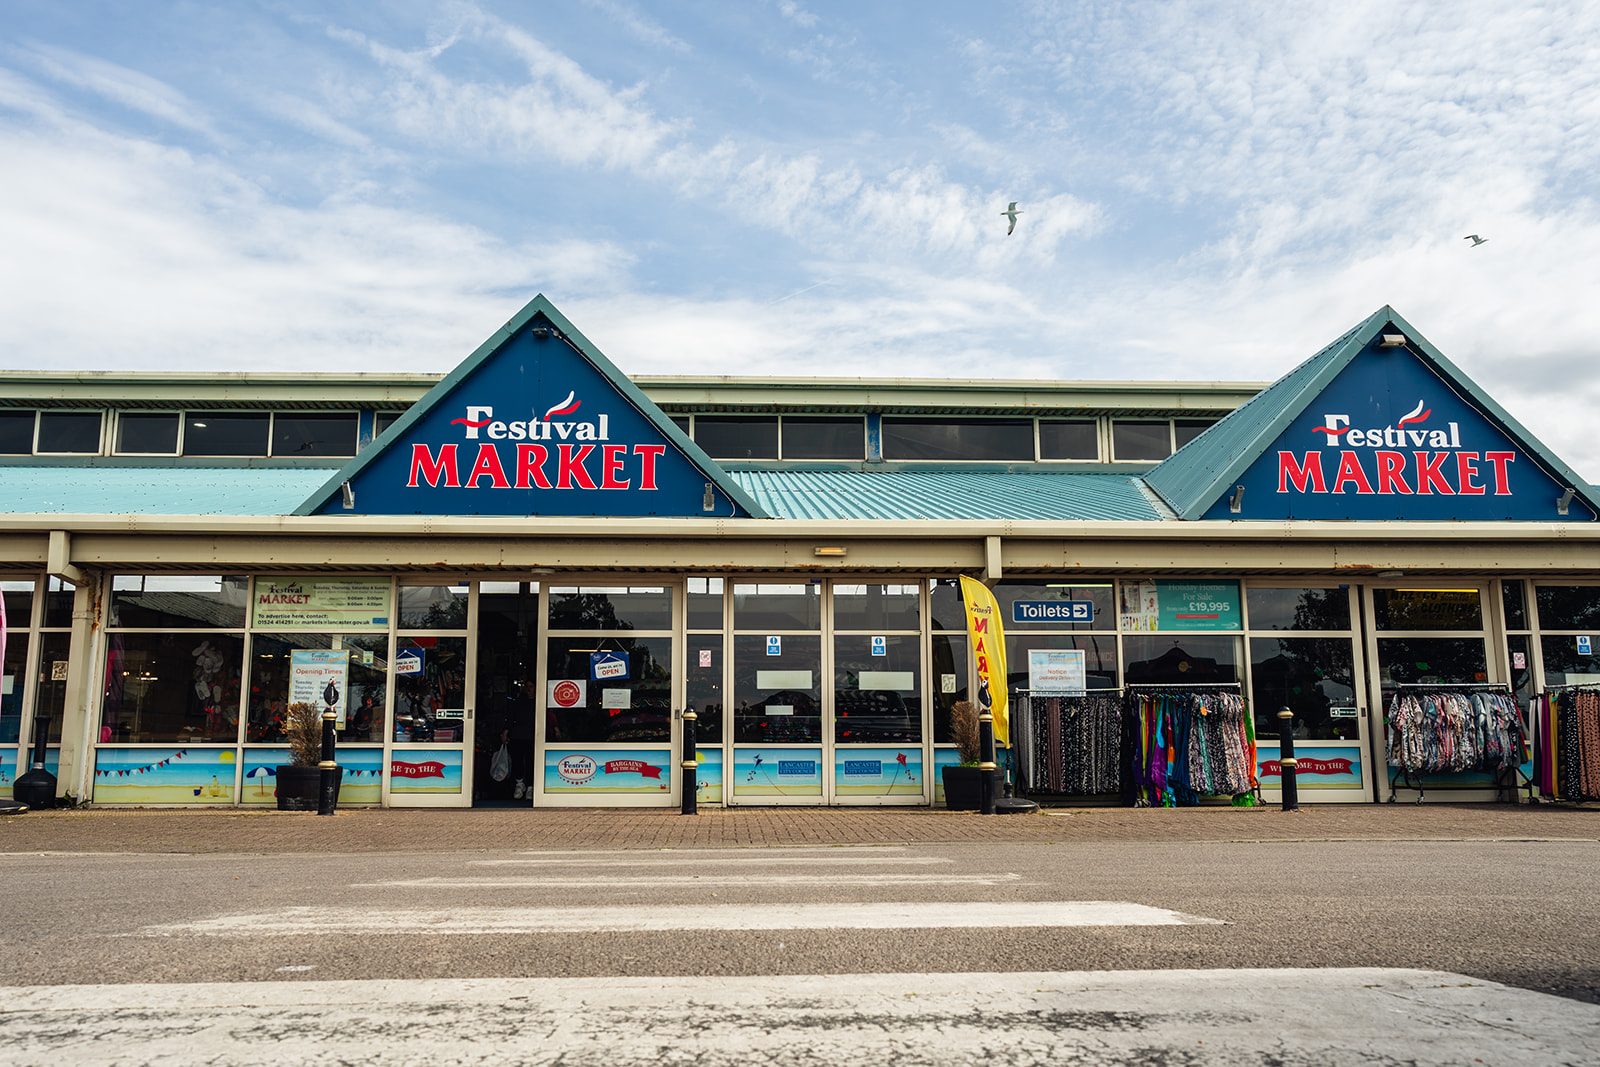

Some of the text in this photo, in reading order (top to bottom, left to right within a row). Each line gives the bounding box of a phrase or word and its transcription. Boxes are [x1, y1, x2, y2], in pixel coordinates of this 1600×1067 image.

[464, 405, 609, 441] Festival
[1323, 413, 1462, 448] Festival
[405, 443, 667, 491] MARKET
[1276, 450, 1516, 496] MARKET
[269, 583, 303, 594] Festival
[1168, 583, 1226, 593] Holiday Homes
[259, 594, 311, 605] MARKET
[1182, 592, 1213, 601] For Sale
[1020, 604, 1070, 618] Toilets
[1189, 602, 1230, 612] £19,995
[397, 664, 414, 672] OPEN
[601, 668, 620, 676] OPEN
[418, 765, 436, 773] THE
[563, 760, 592, 769] Festival
